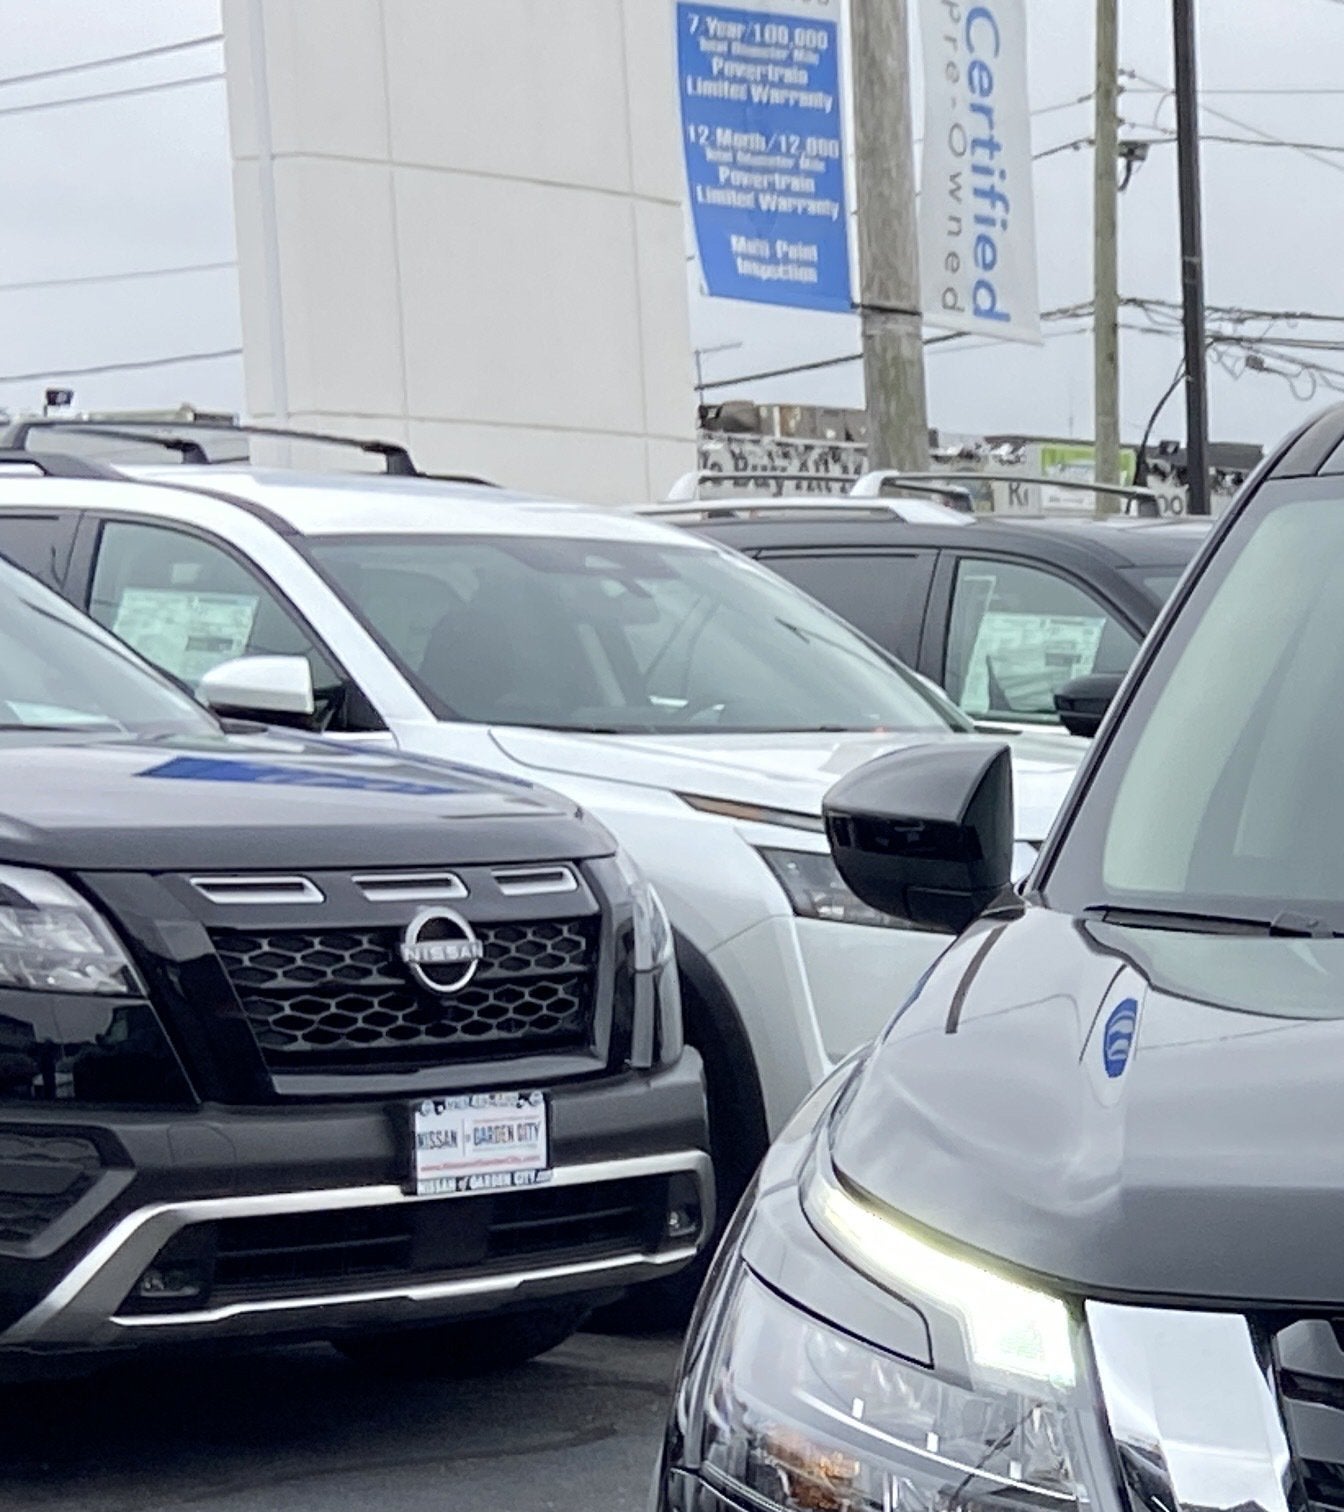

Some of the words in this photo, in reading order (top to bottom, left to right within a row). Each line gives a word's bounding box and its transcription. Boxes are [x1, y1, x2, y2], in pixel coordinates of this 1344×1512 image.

[688, 13, 700, 35] 7
[751, 83, 833, 114] Warranty
[688, 124, 709, 145] 12
[965, 6, 1011, 322] Certified
[719, 165, 815, 193] Powertrain
[696, 183, 755, 209] Limited
[758, 193, 840, 222] Warranty
[403, 943, 483, 962] NISSAN
